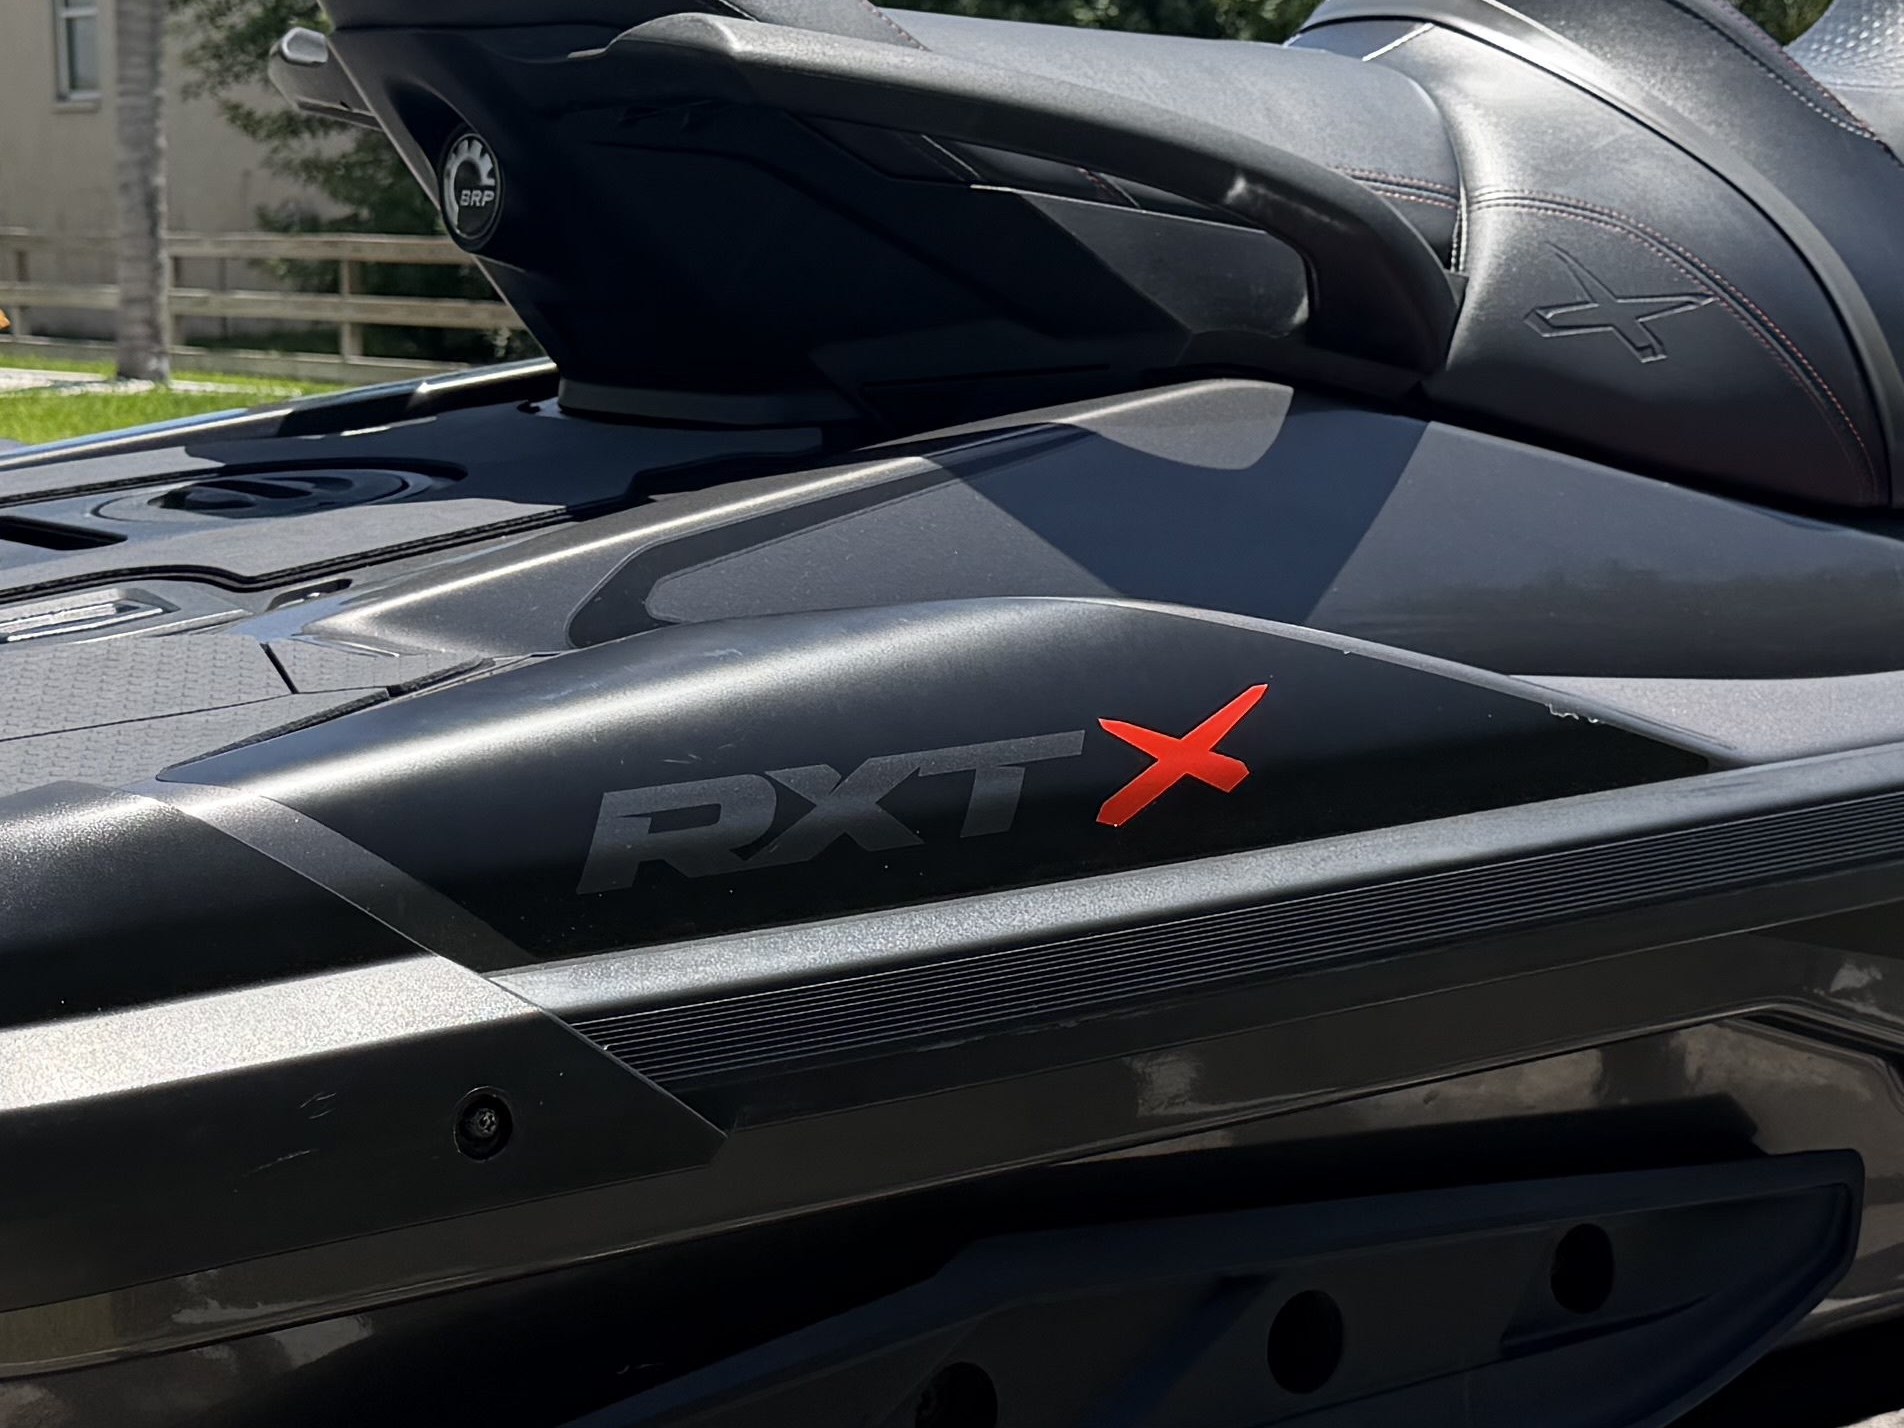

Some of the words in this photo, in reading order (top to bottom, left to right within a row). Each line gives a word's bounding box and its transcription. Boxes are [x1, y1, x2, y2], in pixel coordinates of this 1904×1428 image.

[460, 189, 495, 207] BRP
[578, 729, 1085, 895] RXT
[1095, 682, 1269, 828] X
